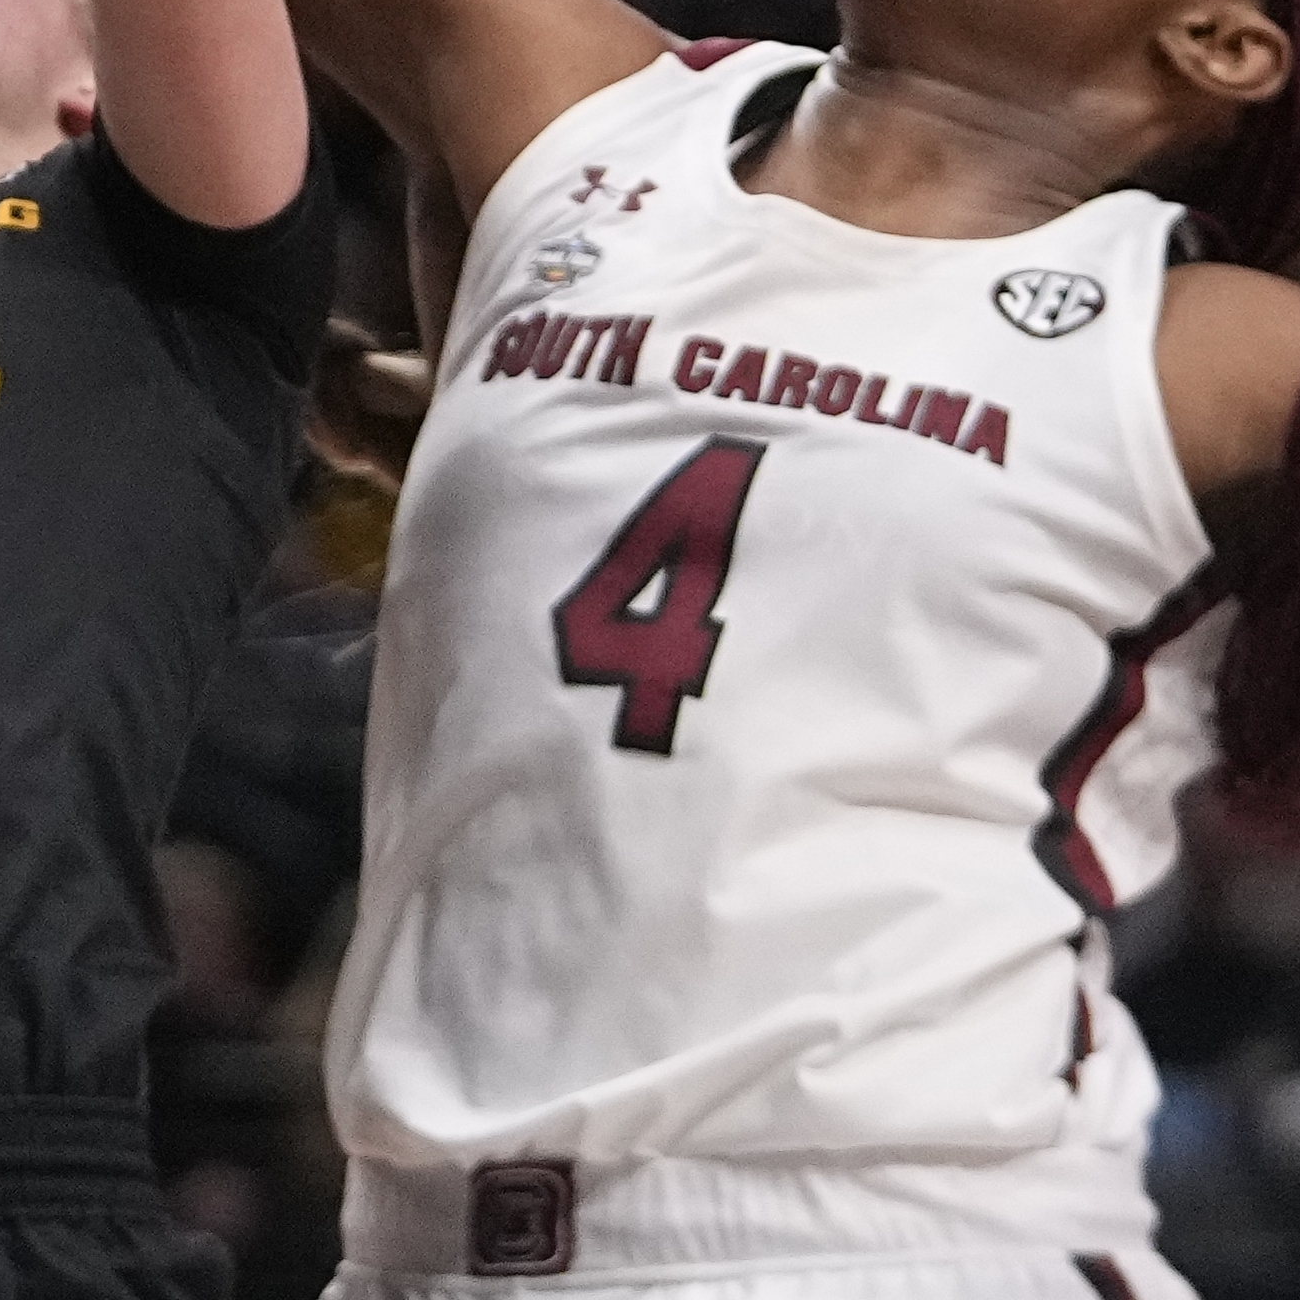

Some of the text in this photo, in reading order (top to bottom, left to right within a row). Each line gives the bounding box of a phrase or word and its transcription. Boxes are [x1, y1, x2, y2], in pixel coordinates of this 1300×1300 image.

[995, 269, 1104, 337] SEC
[673, 333, 1011, 468] CAROLINA
[551, 433, 769, 757] 4
